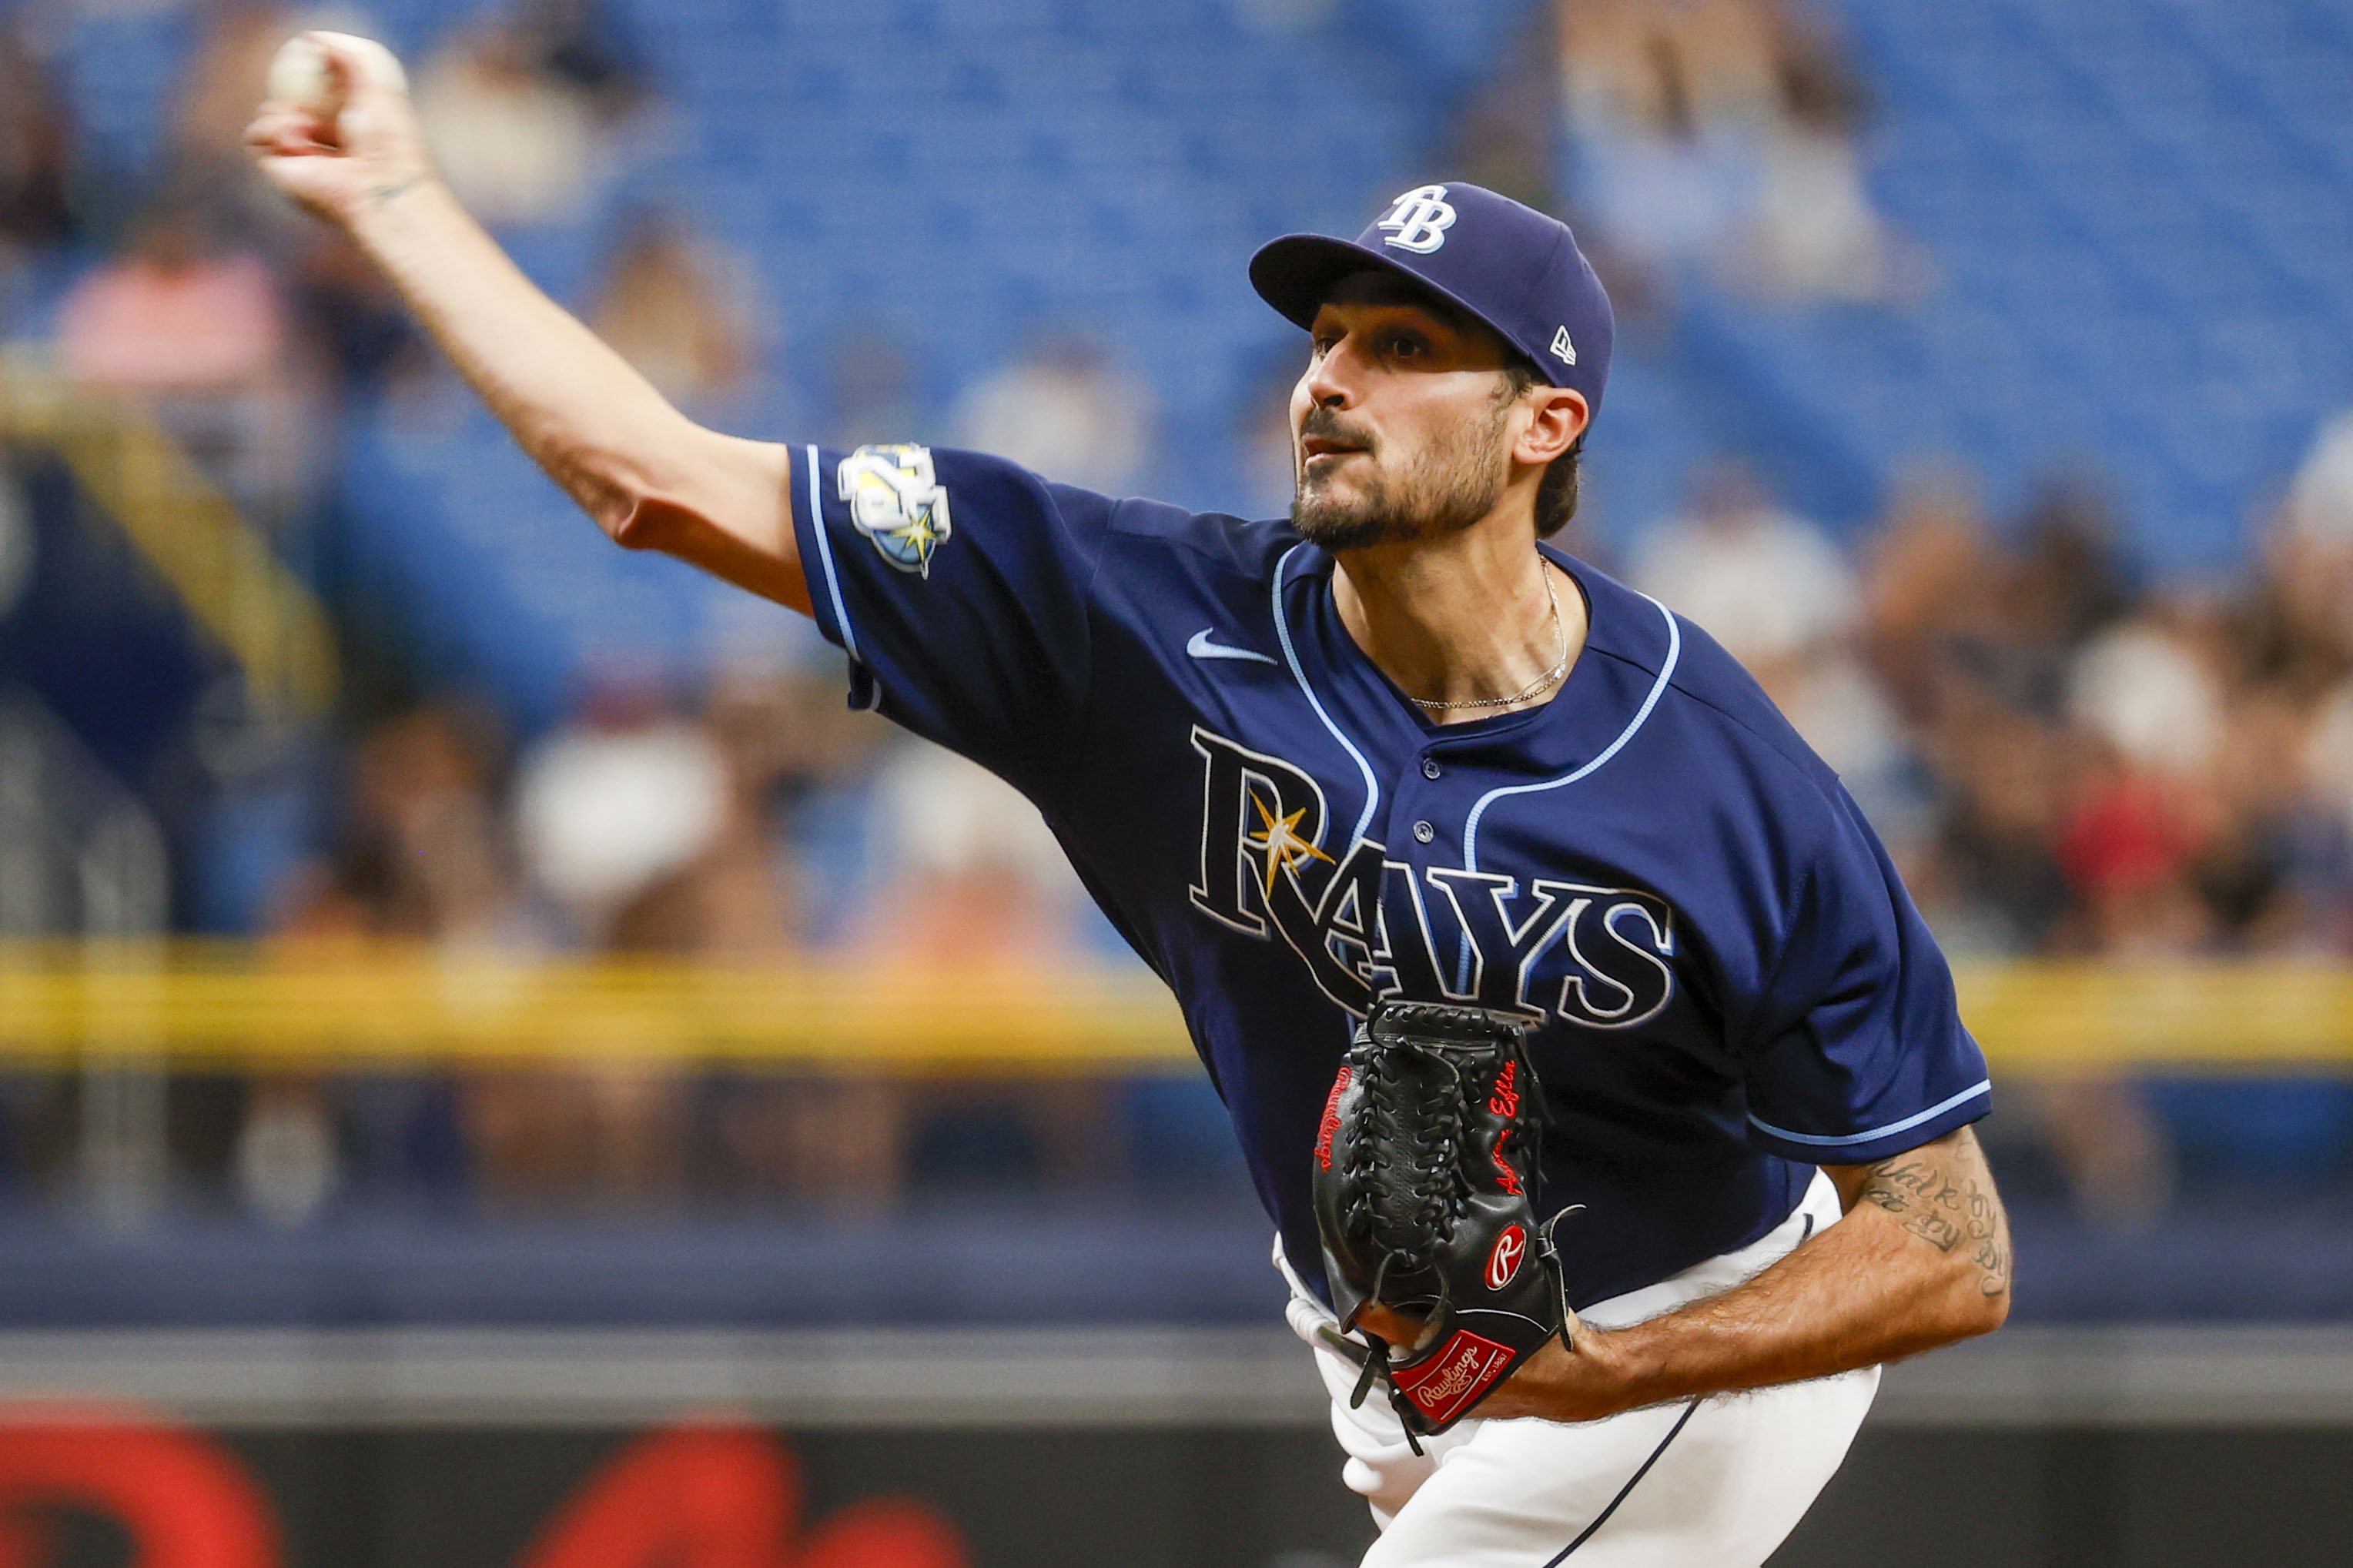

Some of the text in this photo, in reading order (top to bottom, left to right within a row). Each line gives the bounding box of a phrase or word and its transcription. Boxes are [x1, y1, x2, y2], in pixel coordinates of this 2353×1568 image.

[1378, 185, 1458, 254] TB
[1190, 724, 1674, 1030] RAYS
[1417, 1346, 1480, 1408] Rawlings
